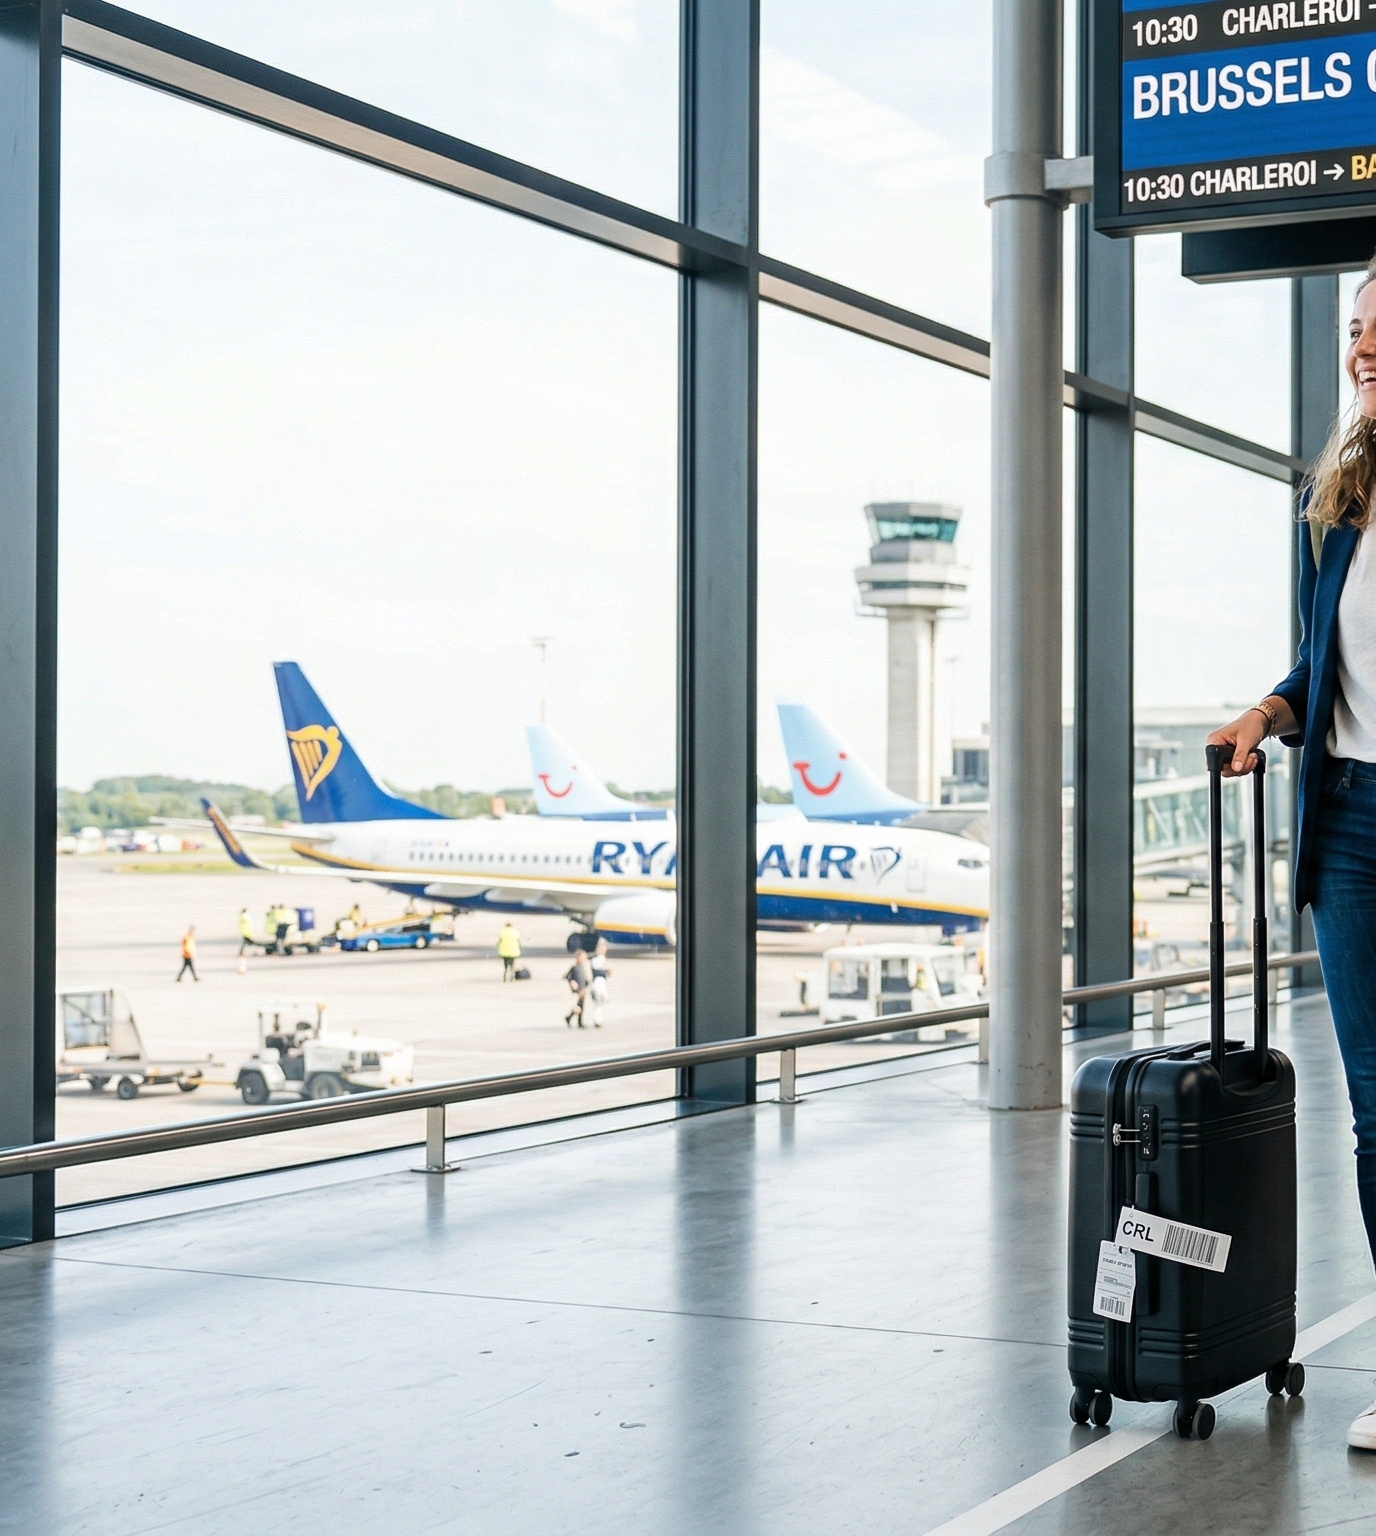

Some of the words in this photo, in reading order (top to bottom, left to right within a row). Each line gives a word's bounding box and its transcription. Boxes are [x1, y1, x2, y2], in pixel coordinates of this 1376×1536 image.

[1132, 14, 1198, 47] 10:30
[1222, 0, 1361, 36] CHARLEROI
[1133, 52, 1352, 119] BRUSSELS
[1124, 173, 1185, 203] 10:30
[1190, 160, 1317, 195] CHARLEROI
[1122, 1220, 1155, 1242] CRL
